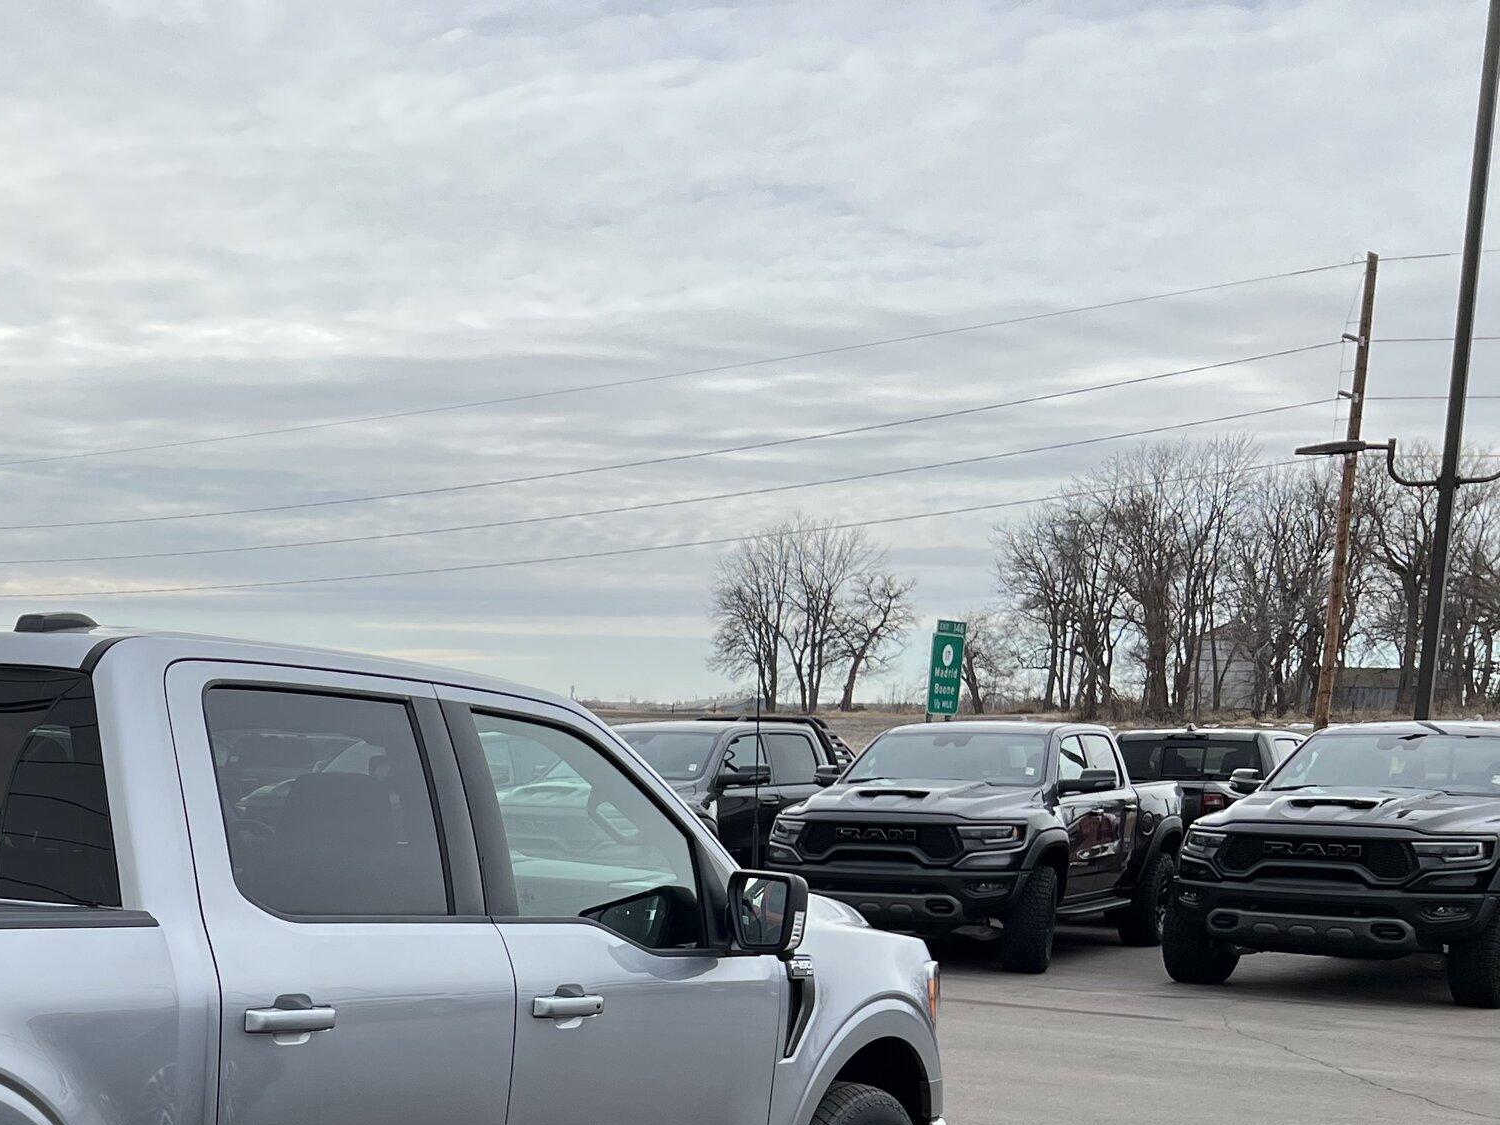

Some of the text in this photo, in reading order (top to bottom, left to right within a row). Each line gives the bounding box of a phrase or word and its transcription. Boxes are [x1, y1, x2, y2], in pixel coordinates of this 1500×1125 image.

[934, 667, 958, 679] Madrid
[934, 683, 955, 695] Boone
[835, 827, 917, 841] RAM
[1263, 841, 1362, 857] RAM
